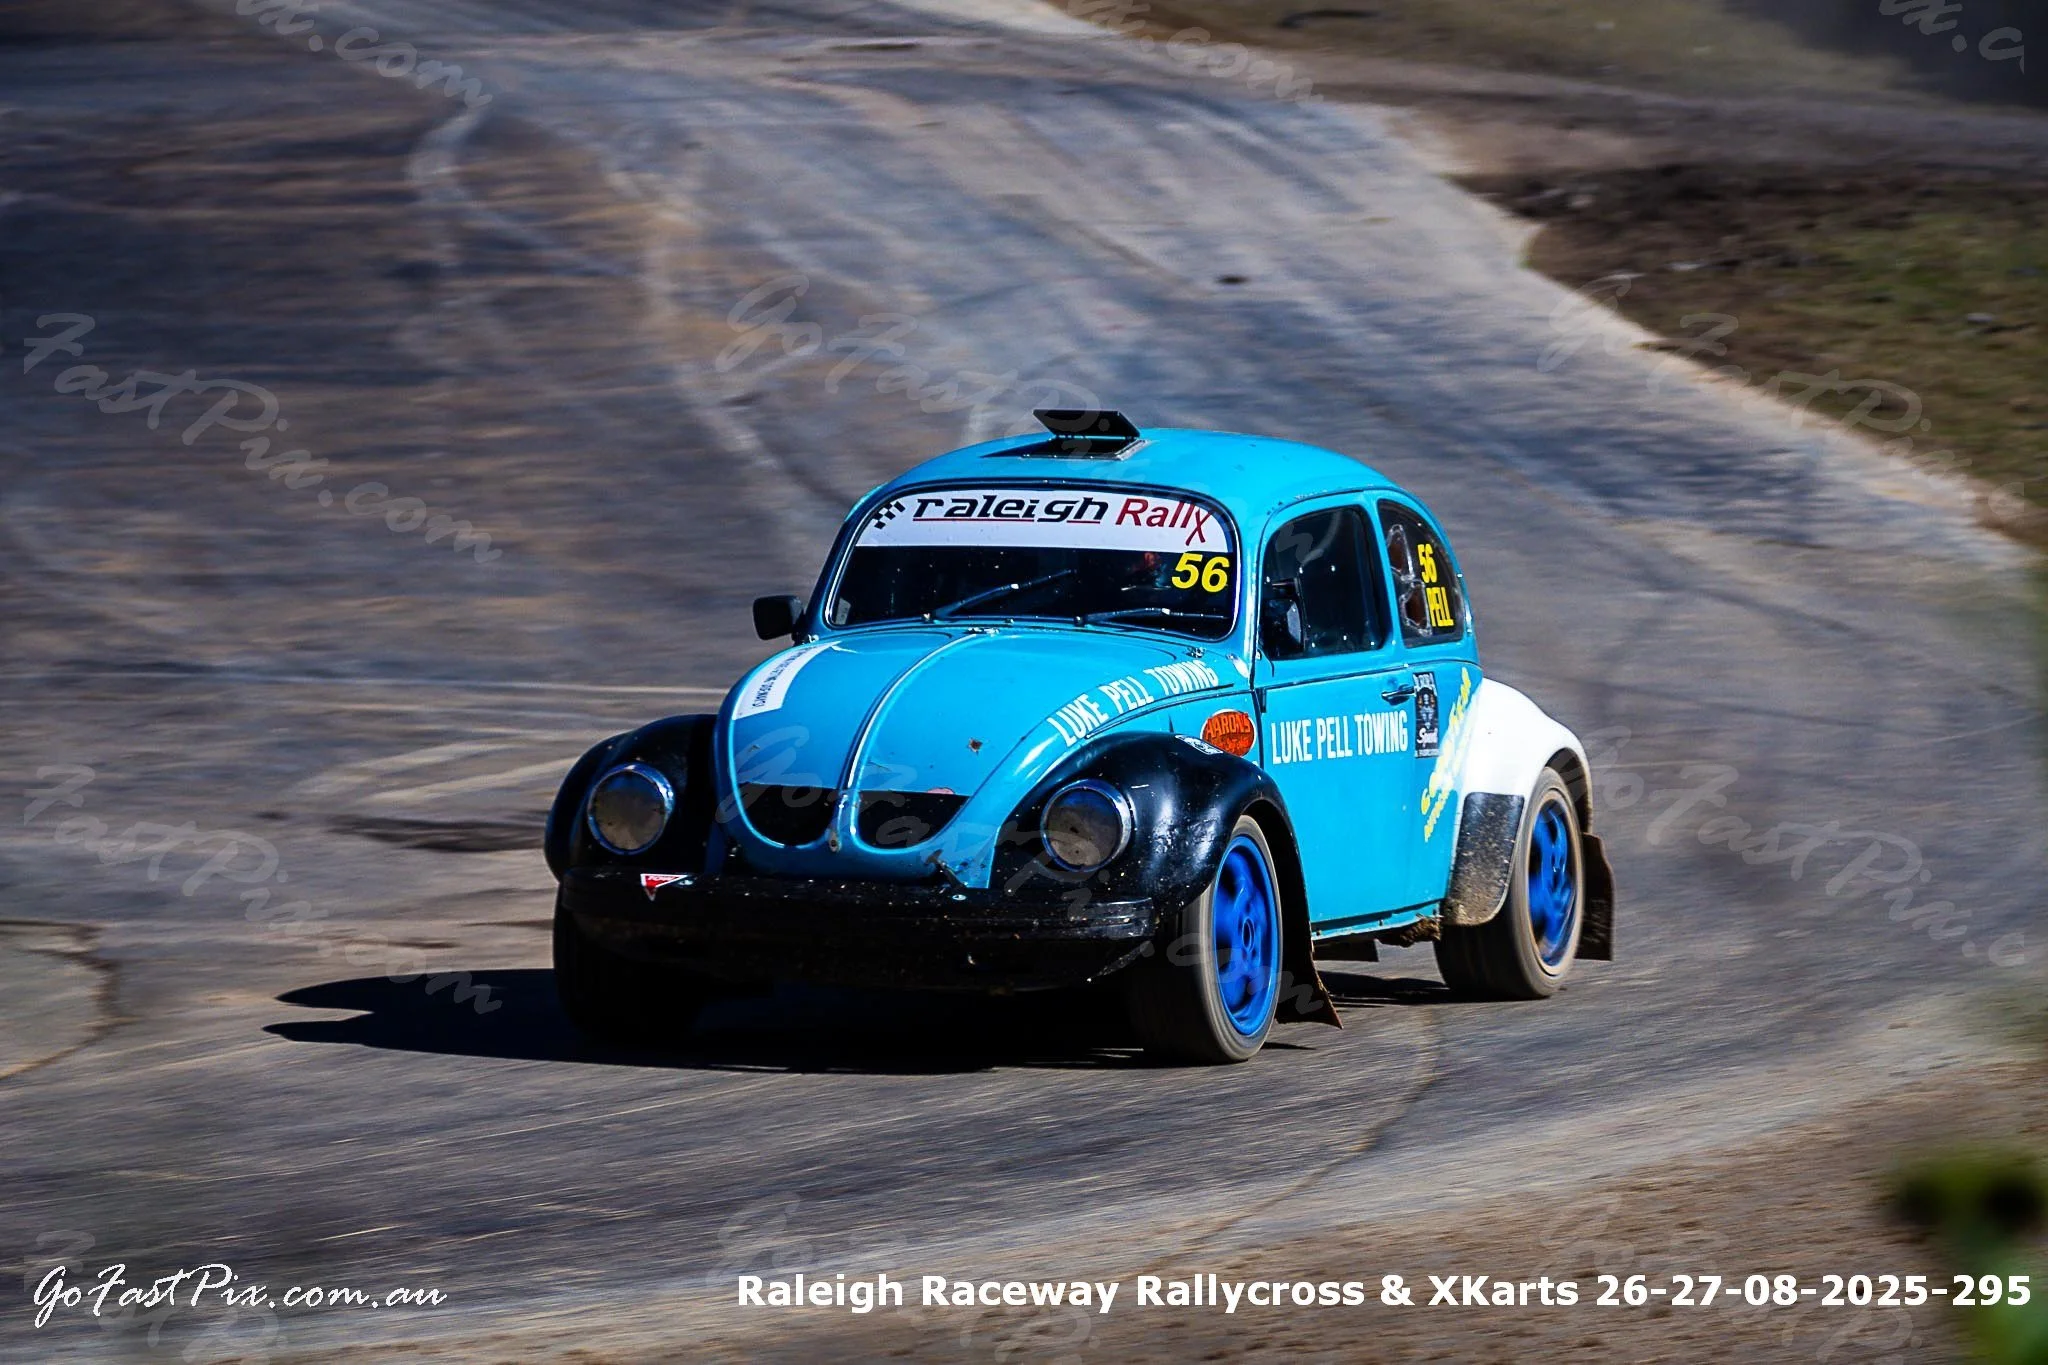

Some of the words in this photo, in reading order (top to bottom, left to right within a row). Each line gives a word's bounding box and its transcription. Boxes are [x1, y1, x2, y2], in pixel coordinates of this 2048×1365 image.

[913, 495, 1109, 522] raleigh
[1171, 552, 1230, 593] 56
[1417, 543, 1437, 583] 56
[1426, 587, 1454, 627] PELL
[1047, 692, 1109, 747] LUKE
[1098, 676, 1155, 714] PELL
[1143, 659, 1219, 696] TOWING
[1271, 719, 1312, 764] LUKE
[1316, 715, 1353, 760] PELL
[1354, 709, 1409, 756] TOWING
